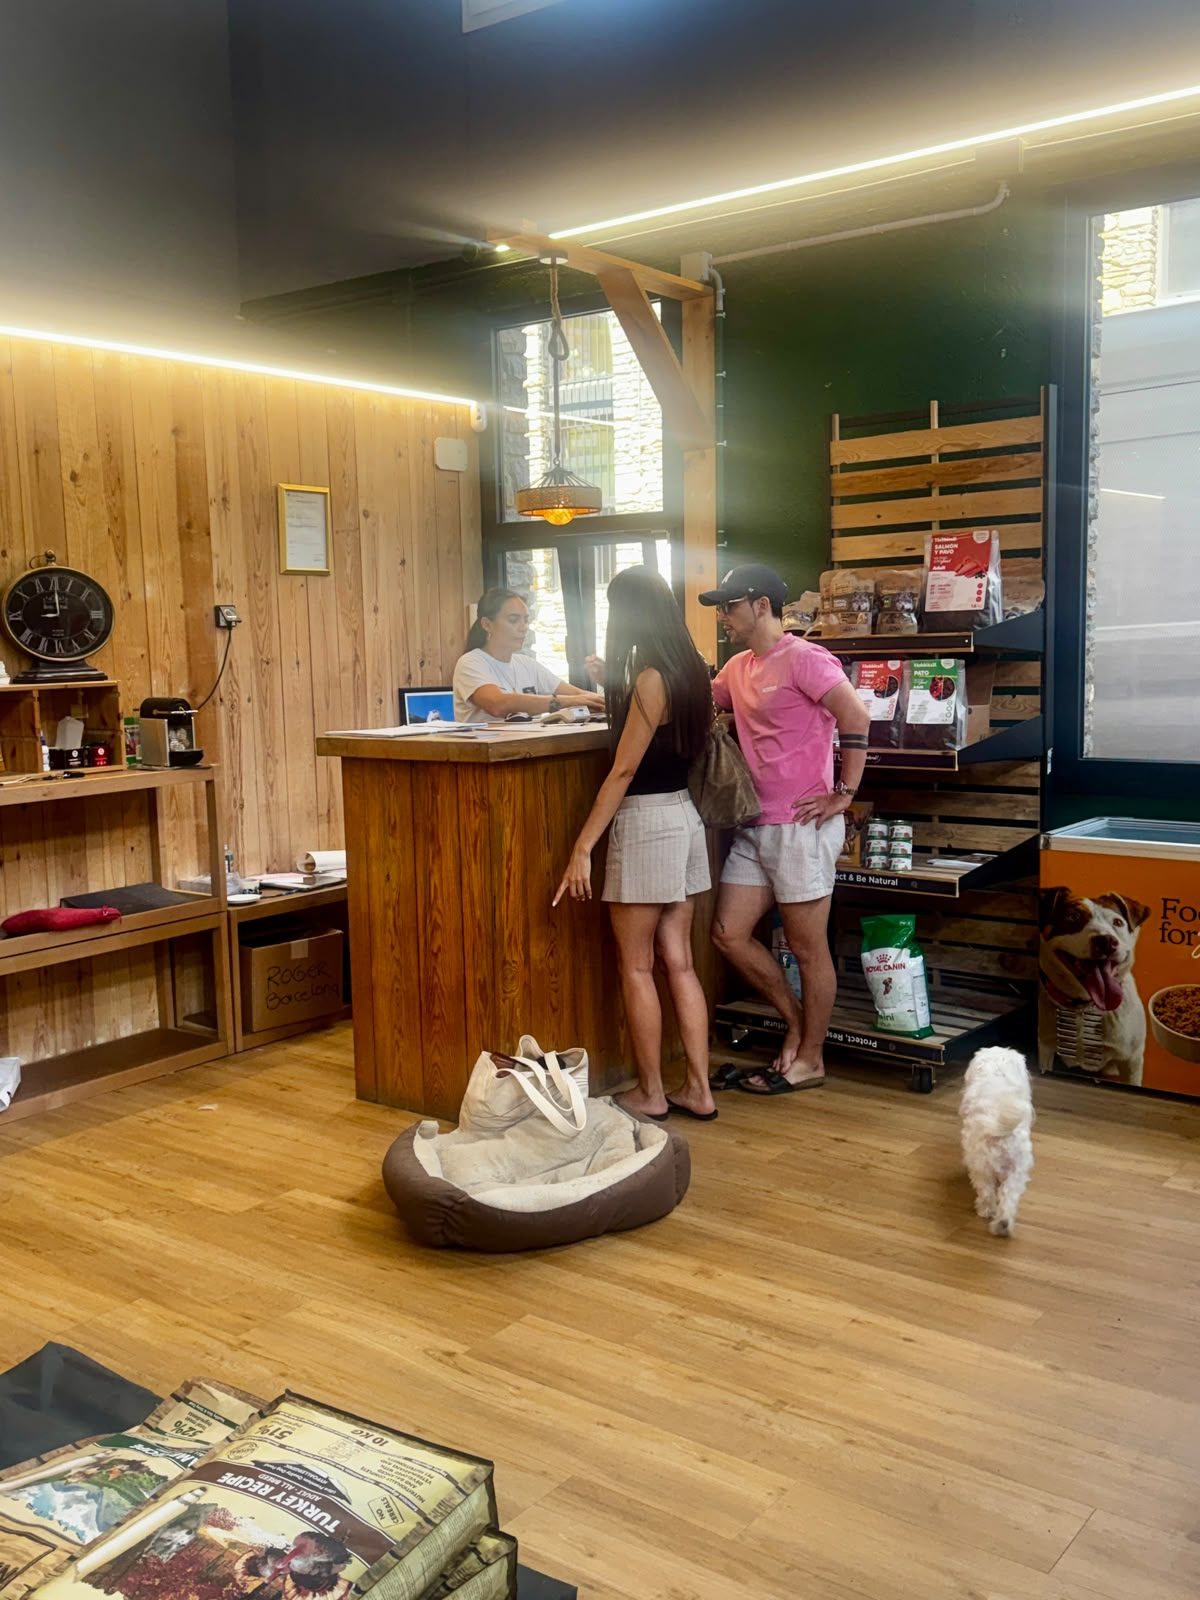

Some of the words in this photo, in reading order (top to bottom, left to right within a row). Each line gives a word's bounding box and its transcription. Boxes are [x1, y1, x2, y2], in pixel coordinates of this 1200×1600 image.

[856, 874, 867, 883] Be
[868, 876, 898, 886] Natural
[1161, 897, 1200, 923] Fo
[1159, 921, 1198, 946] for
[883, 963, 906, 971] CANIN
[763, 1019, 788, 1030] atural
[845, 1034, 878, 1048] Protect,
[171, 1420, 204, 1438] 52%
[255, 1424, 293, 1440] 51%
[350, 1429, 374, 1439] KG
[371, 1436, 389, 1447] 10
[217, 1472, 275, 1497] RECIPE
[258, 1473, 281, 1485] BREED
[280, 1480, 294, 1491] ALL
[296, 1488, 322, 1502] ADULT
[269, 1491, 341, 1533] TURKEY
[376, 1508, 387, 1521] NO
[380, 1496, 400, 1525] CEREALS
